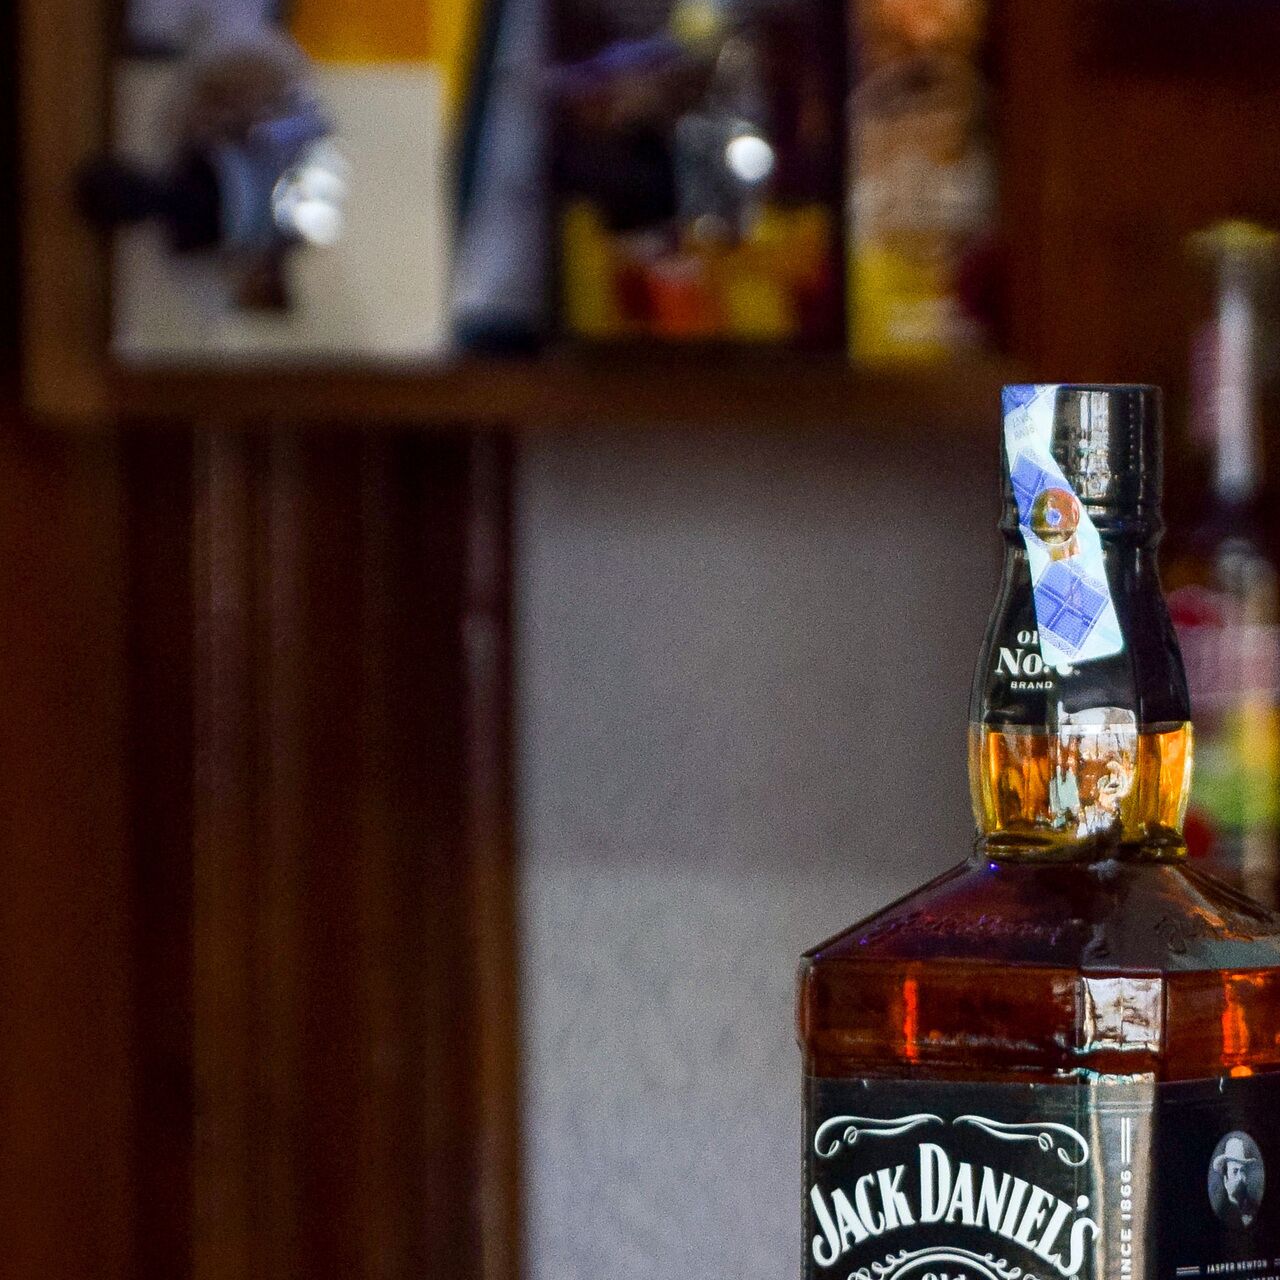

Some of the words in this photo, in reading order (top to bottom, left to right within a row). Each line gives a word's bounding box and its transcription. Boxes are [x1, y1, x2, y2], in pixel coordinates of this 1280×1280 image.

[1017, 630, 1039, 645] Ol
[1010, 680, 1054, 690] BRAND
[810, 1165, 916, 1268] JACK
[919, 1142, 1101, 1277] DANIEL'S
[1120, 1169, 1133, 1221] 1866
